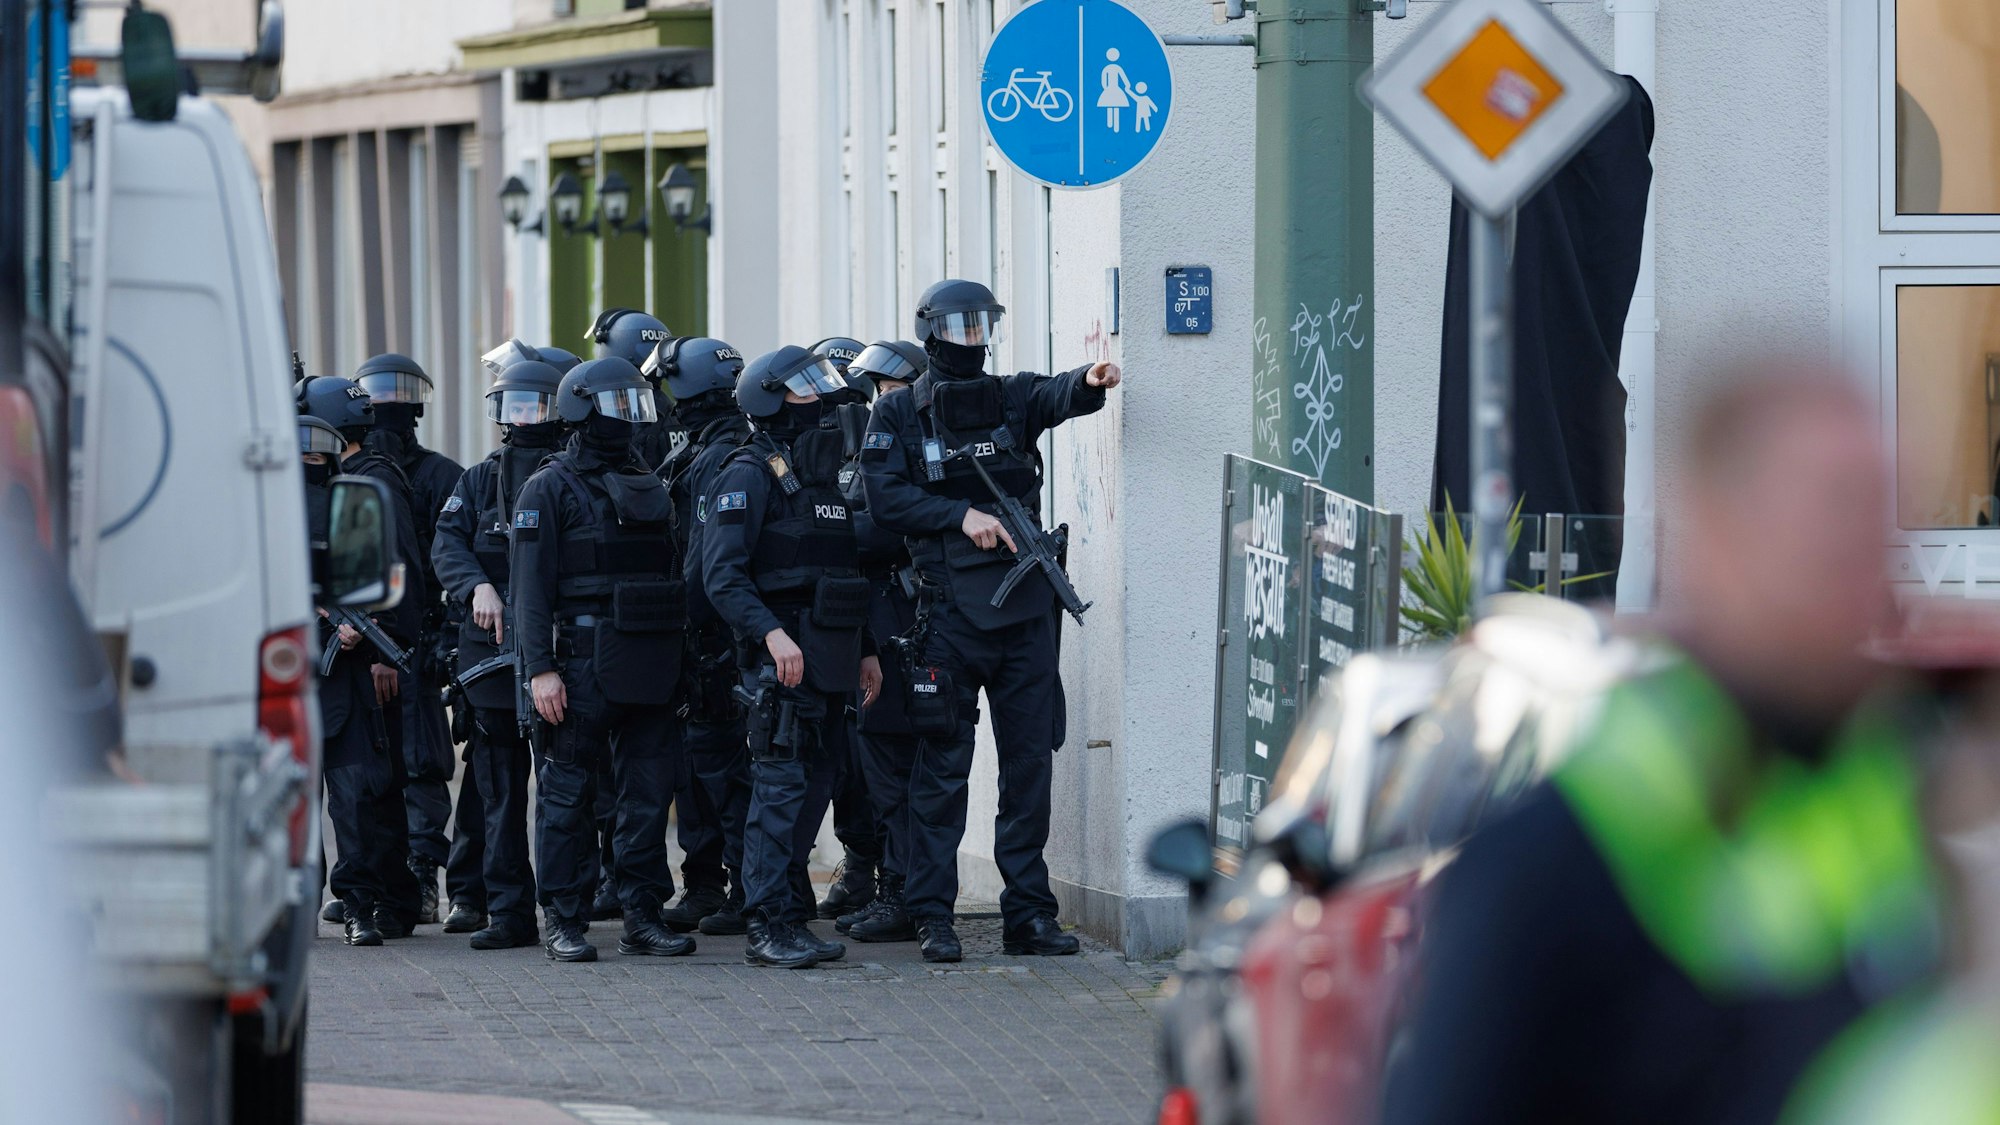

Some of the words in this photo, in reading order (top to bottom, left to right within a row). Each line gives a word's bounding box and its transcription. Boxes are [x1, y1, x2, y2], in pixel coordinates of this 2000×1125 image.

[1180, 281, 1189, 296] S
[1192, 286, 1209, 296] 100
[1174, 303, 1186, 313] 07
[1186, 317, 1198, 328] 05
[828, 348, 859, 361] POLIZE
[814, 504, 847, 520] POLIZEI
[913, 683, 937, 693] POLIZEI
